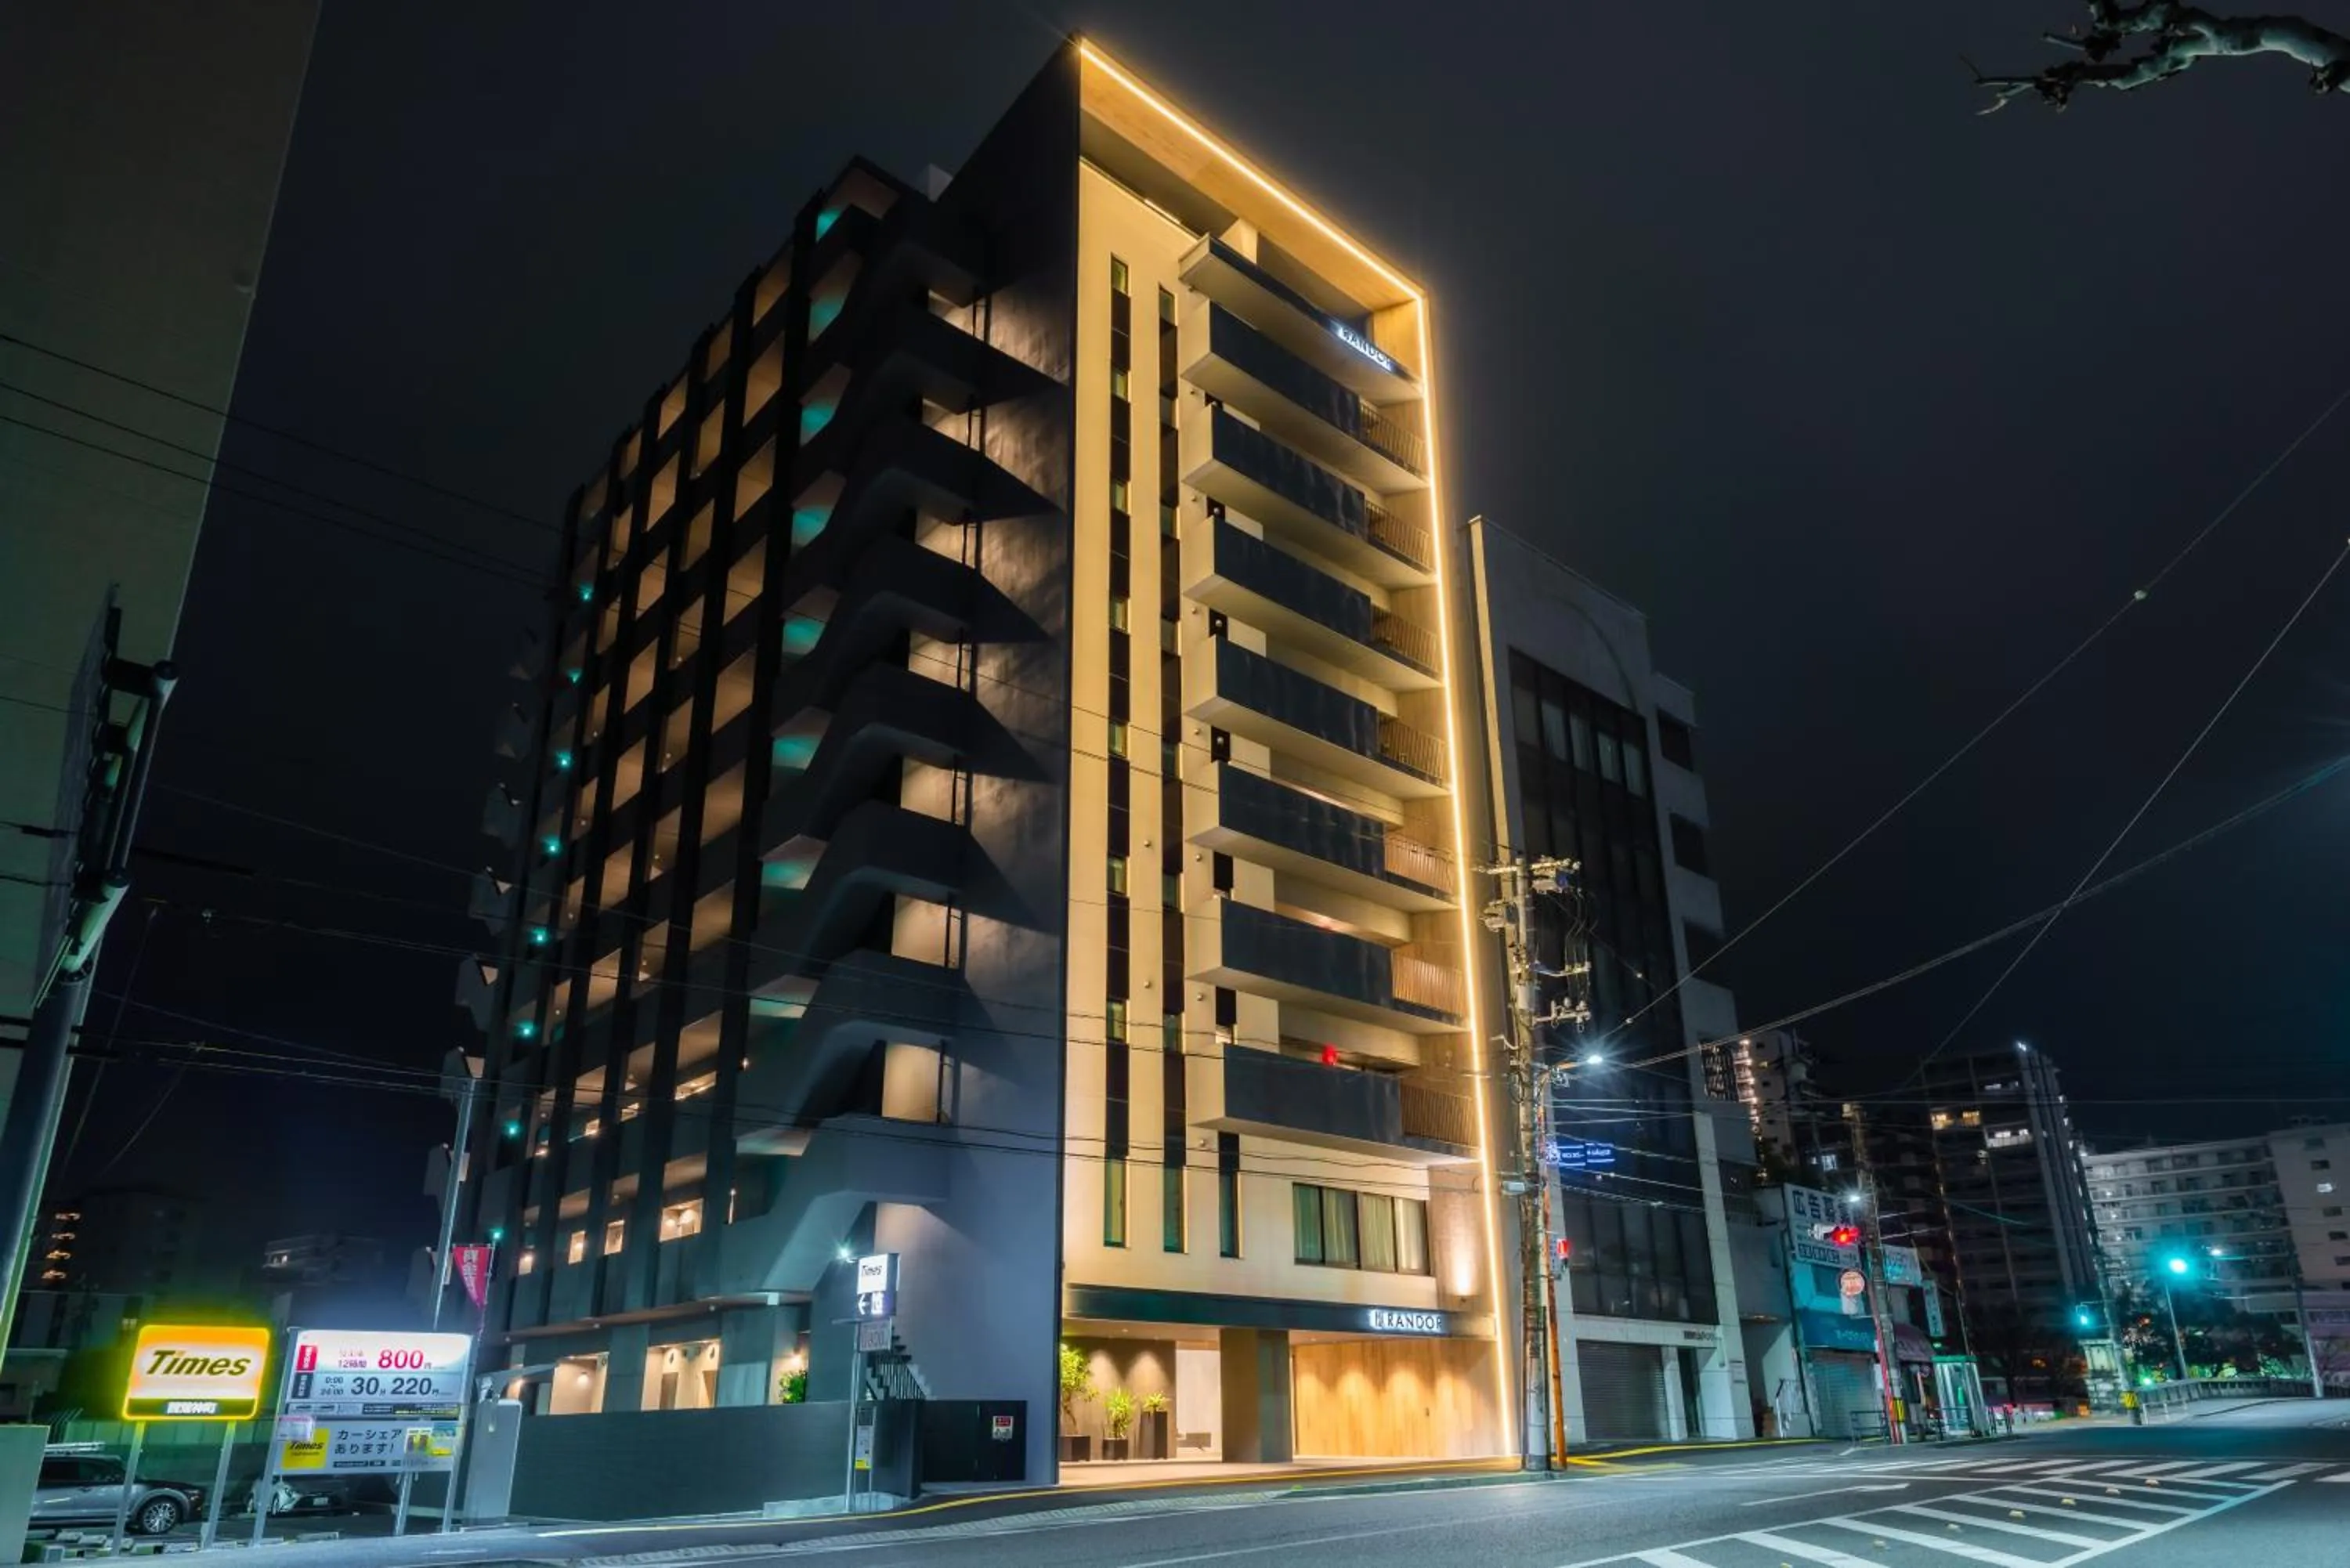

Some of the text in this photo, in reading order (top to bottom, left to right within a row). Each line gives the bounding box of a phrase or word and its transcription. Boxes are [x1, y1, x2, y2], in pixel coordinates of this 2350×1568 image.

[146, 1349, 251, 1376] Times
[337, 1429, 403, 1440] カーシェア
